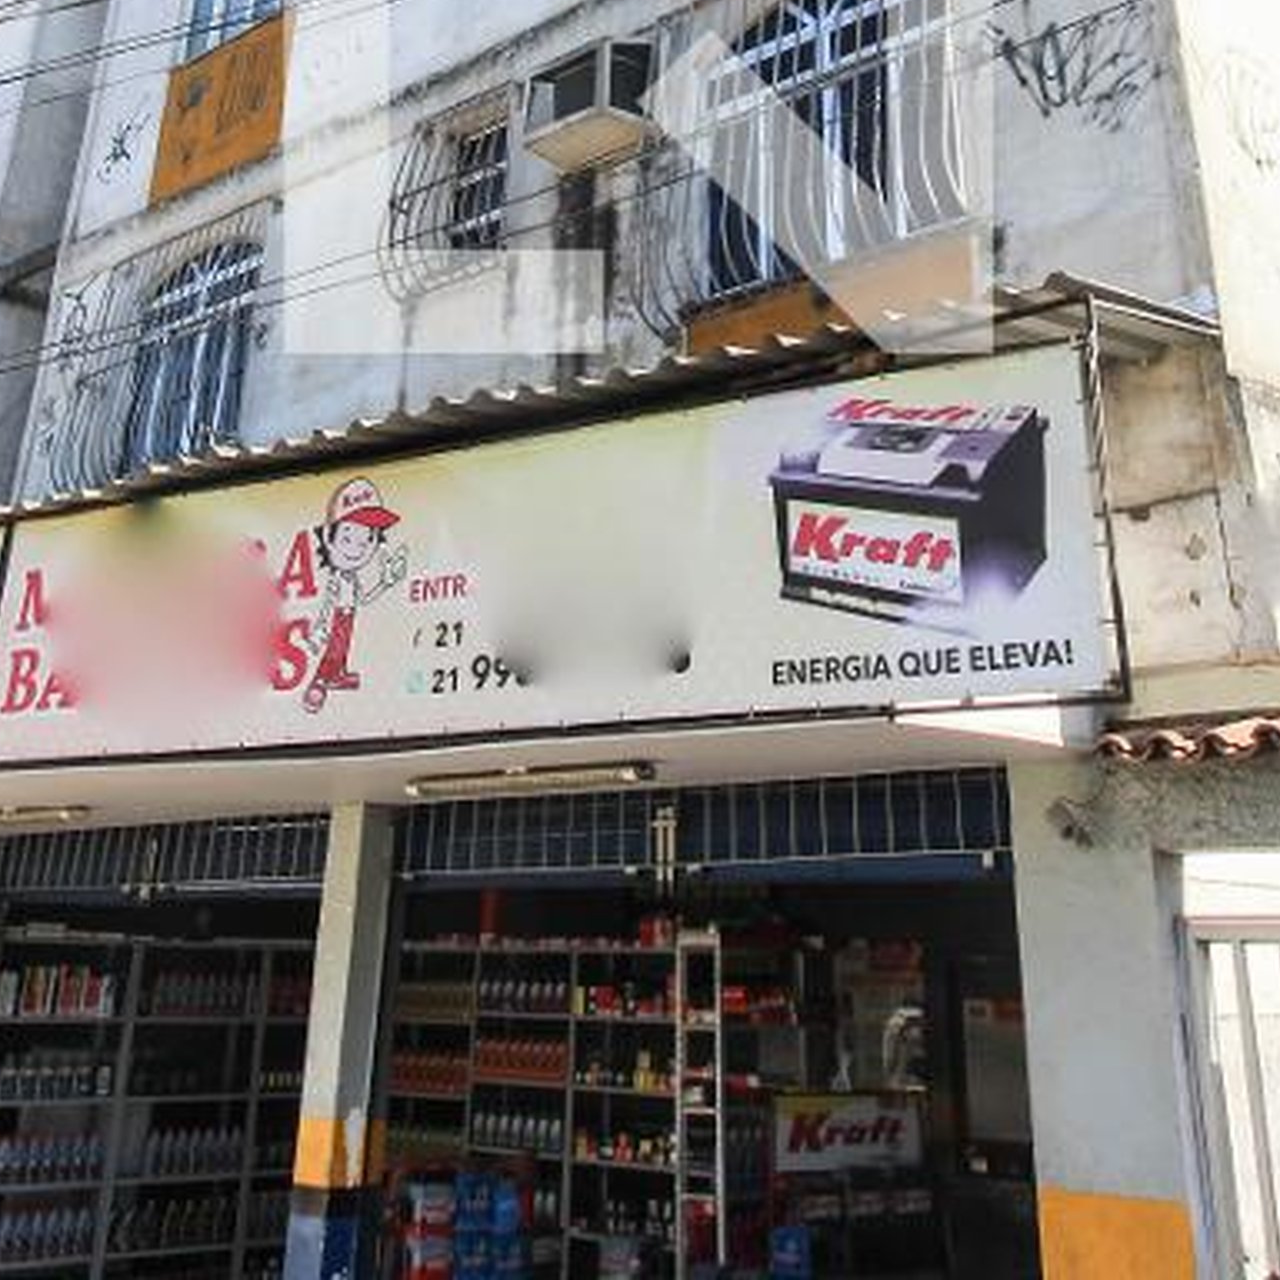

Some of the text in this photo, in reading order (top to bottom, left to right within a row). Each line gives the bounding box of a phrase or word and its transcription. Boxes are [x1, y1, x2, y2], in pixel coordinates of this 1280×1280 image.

[792, 512, 955, 571] Kraft
[409, 574, 468, 603] ENTR
[772, 639, 1074, 686] ENERGIA QUE ELEVA!
[788, 1111, 906, 1154] Kraft
